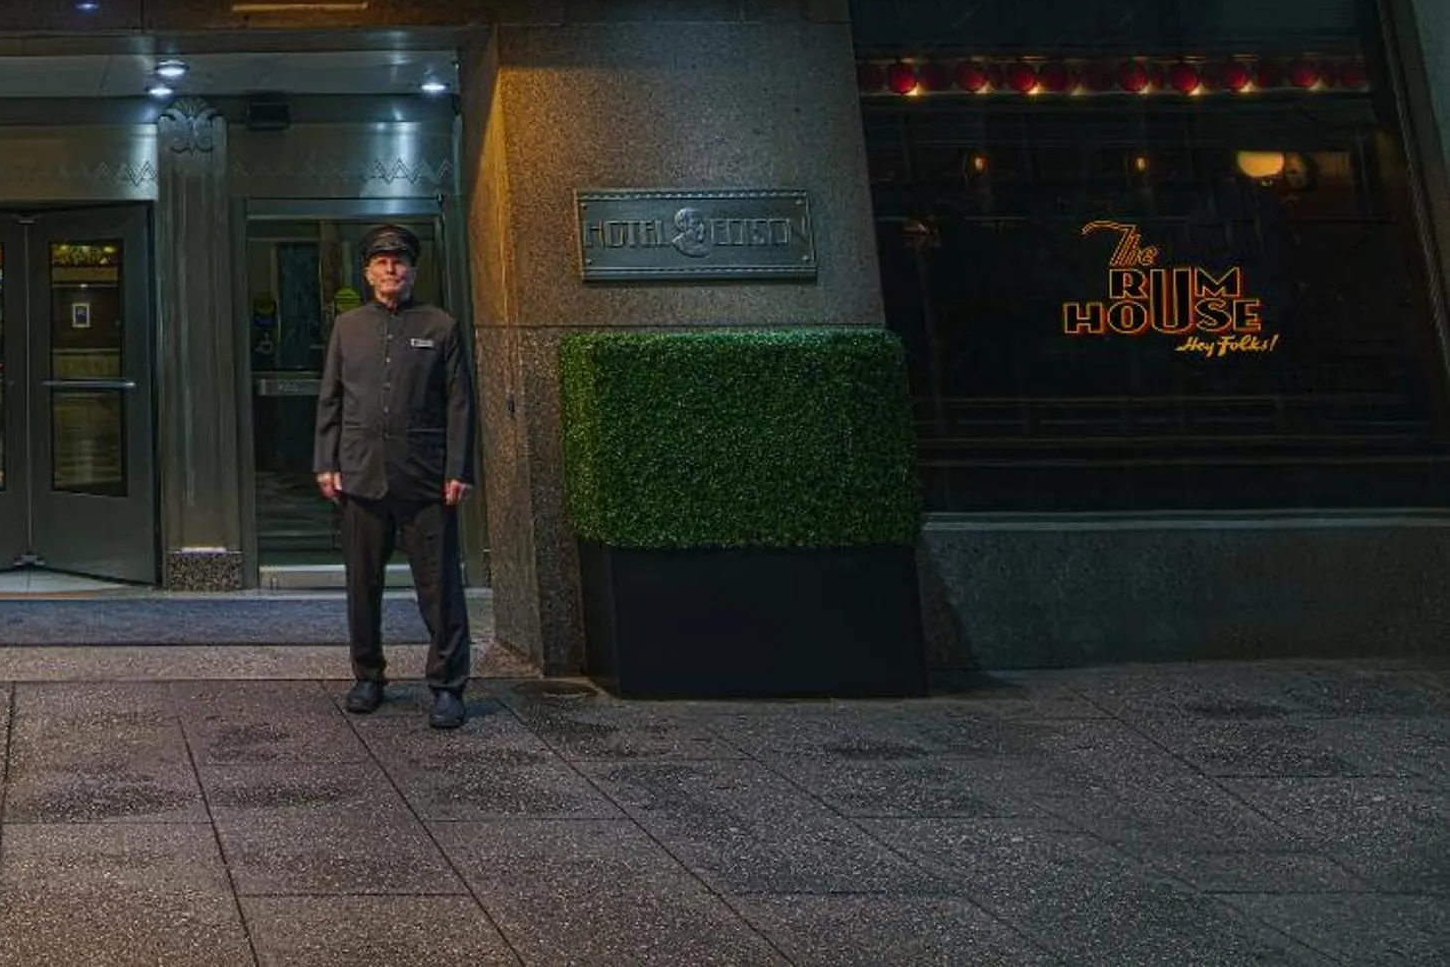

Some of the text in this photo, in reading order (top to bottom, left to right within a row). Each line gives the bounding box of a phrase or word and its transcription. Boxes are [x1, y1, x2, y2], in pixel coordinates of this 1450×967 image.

[583, 217, 807, 248] HOTEL EDISON
[1081, 220, 1159, 266] The
[1175, 335, 1215, 358] Hey
